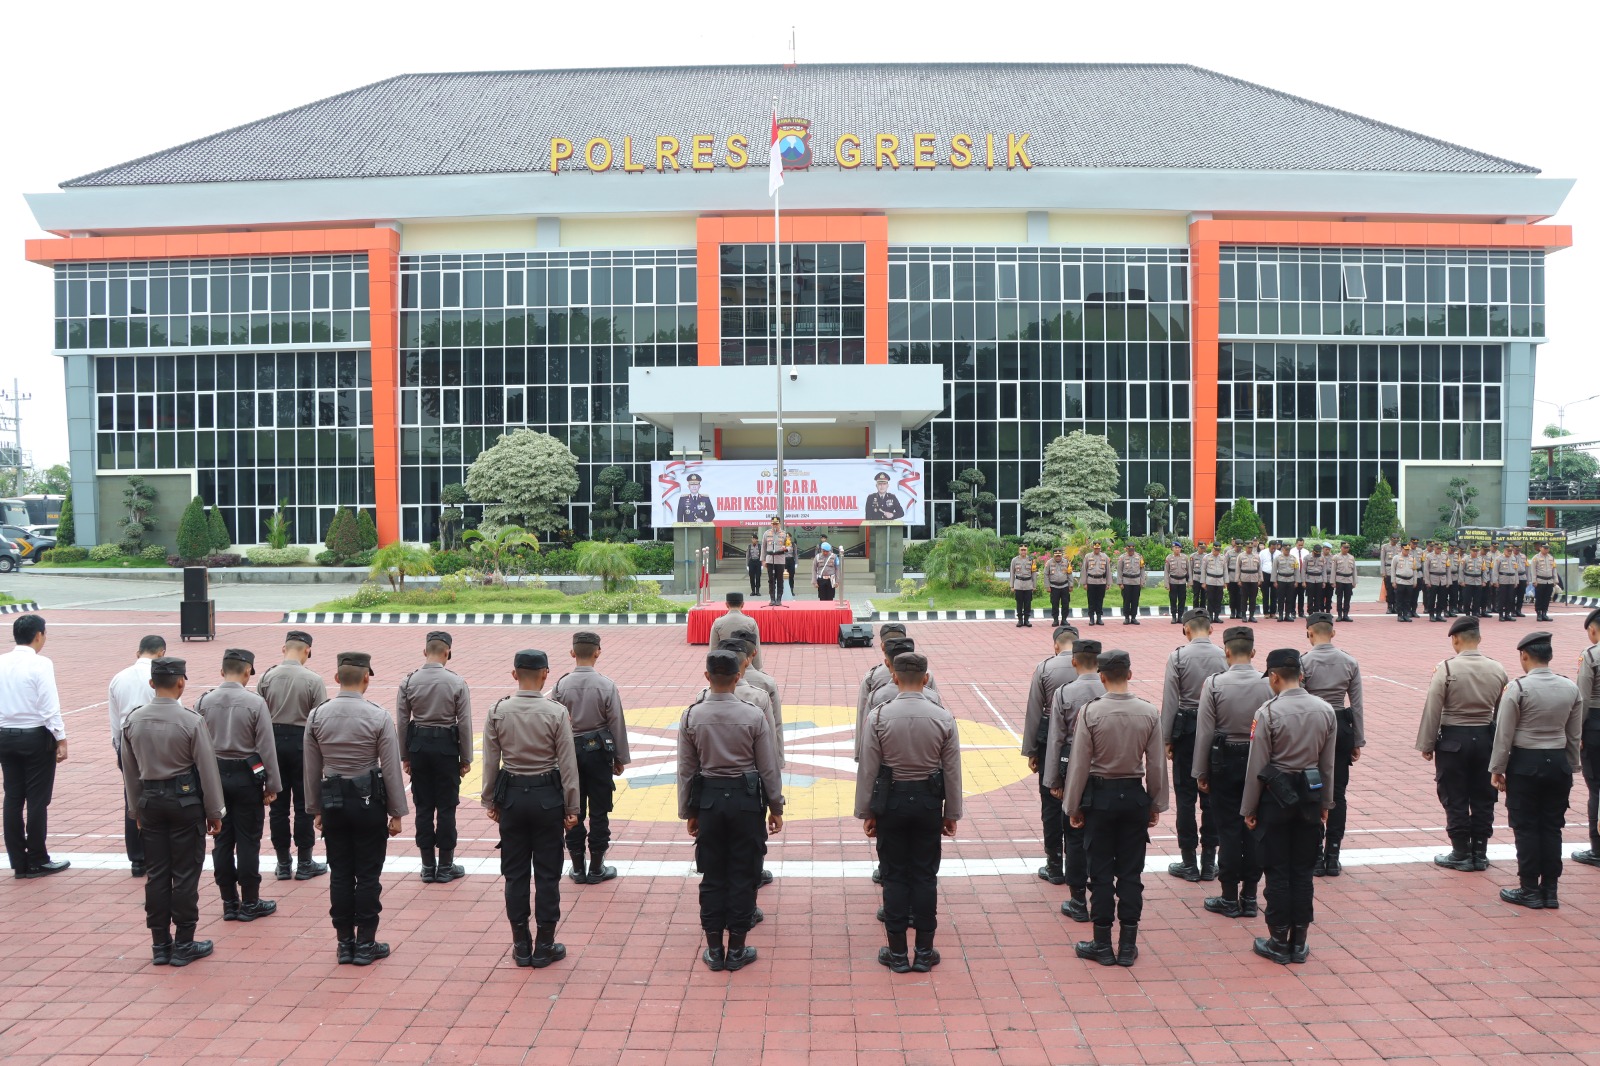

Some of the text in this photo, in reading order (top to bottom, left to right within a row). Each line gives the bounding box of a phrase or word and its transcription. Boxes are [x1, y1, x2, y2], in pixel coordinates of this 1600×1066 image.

[550, 132, 1033, 173] POLRES GRESIK
[717, 495, 858, 511] HARI KESADRAN NASIONAL
